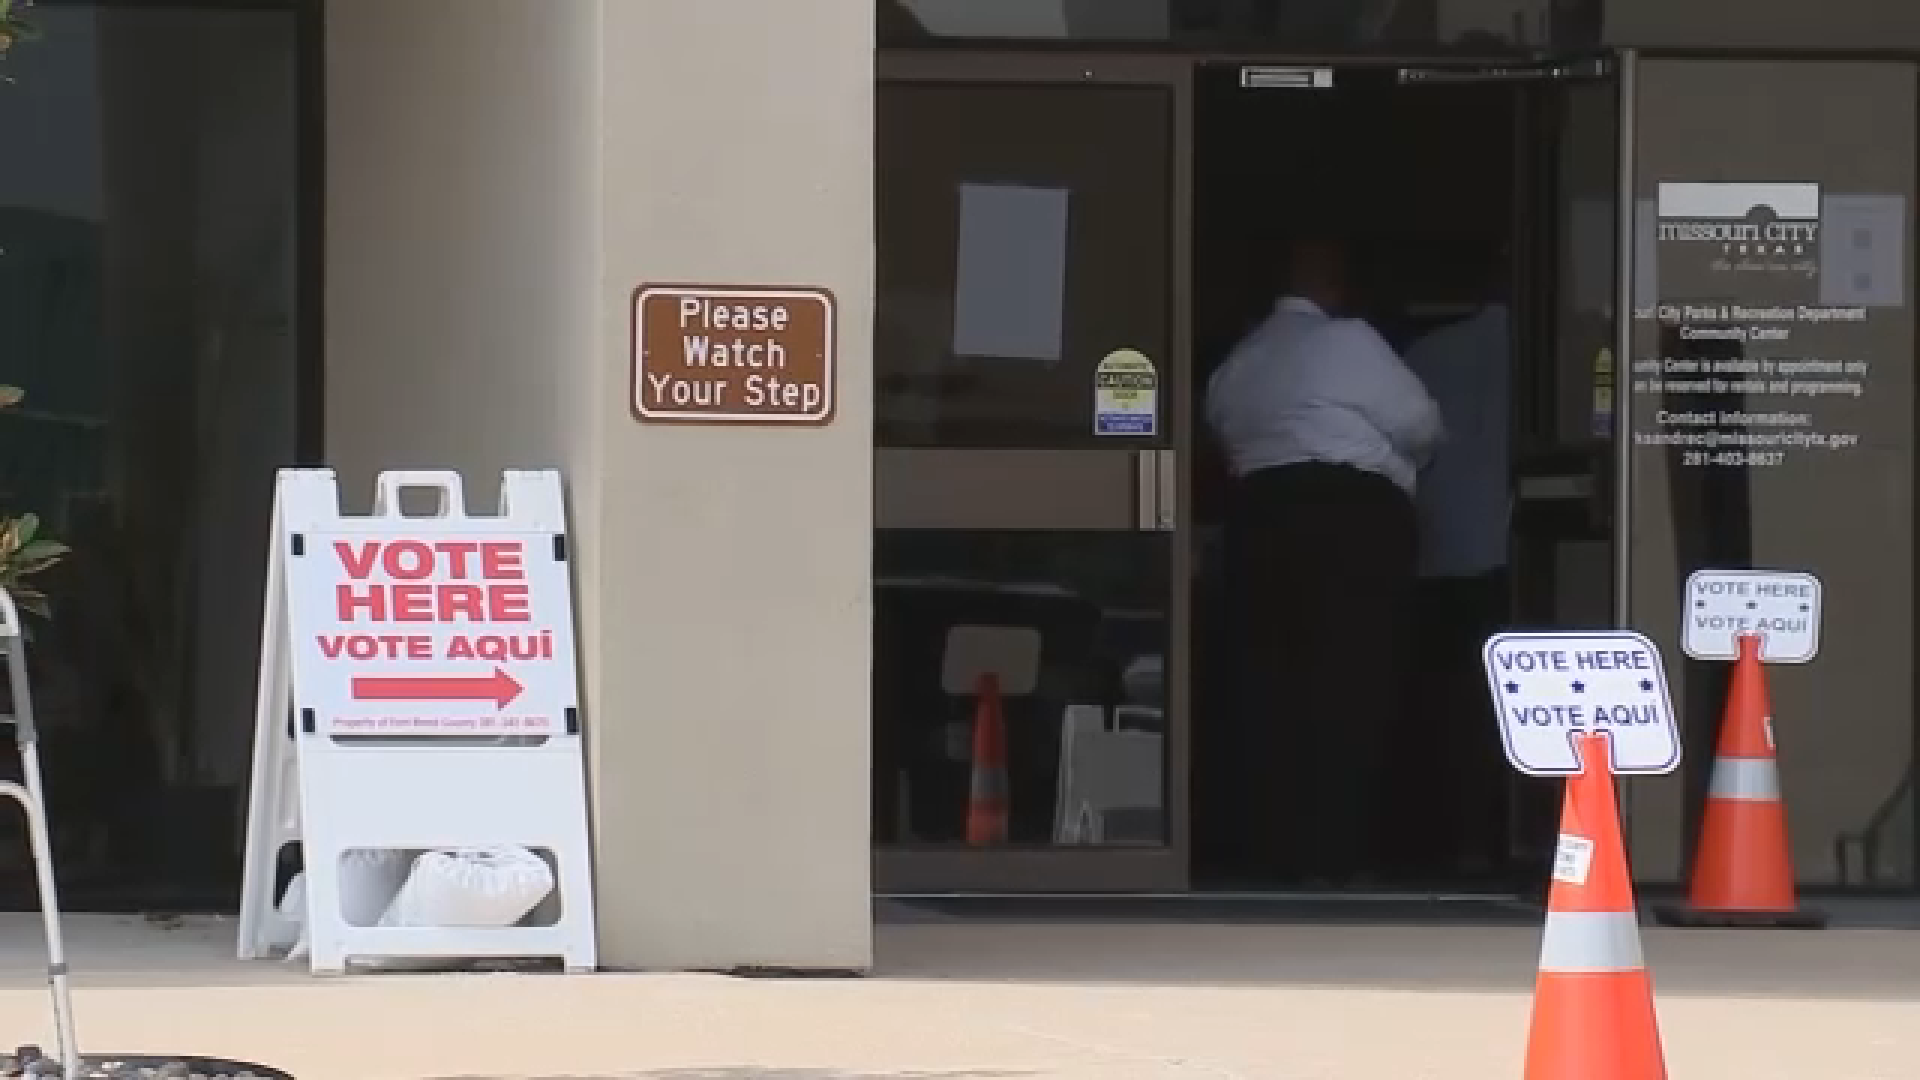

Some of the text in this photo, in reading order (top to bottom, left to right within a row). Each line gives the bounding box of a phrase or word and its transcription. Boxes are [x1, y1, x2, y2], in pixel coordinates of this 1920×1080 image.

[1763, 221, 1819, 241] CITY
[1721, 243, 1804, 255] TEXAS
[679, 298, 789, 330] Please
[1658, 305, 1681, 322] City
[1683, 305, 1717, 319] Parks
[1731, 305, 1795, 319] Recreation
[1797, 305, 1867, 323] Department
[1680, 327, 1790, 342] Community Center
[683, 335, 786, 369] Watch
[1664, 360, 1699, 373] Center
[1763, 360, 1775, 376] by
[1777, 360, 1843, 376] appointment
[1845, 360, 1869, 376] only
[648, 372, 821, 413] Your Step
[1769, 380, 1789, 393] and
[1656, 411, 1813, 425] Contact Information:
[333, 540, 525, 580] VOTE
[1695, 580, 1812, 599] VOTE HERE
[335, 584, 531, 623] HERE
[1695, 616, 1749, 632] VOTE
[315, 635, 433, 661] VOTE
[1497, 649, 1652, 672] VOTE HERE
[332, 716, 376, 729] Property
[377, 716, 388, 728] of
[1511, 704, 1586, 728] VOTE
